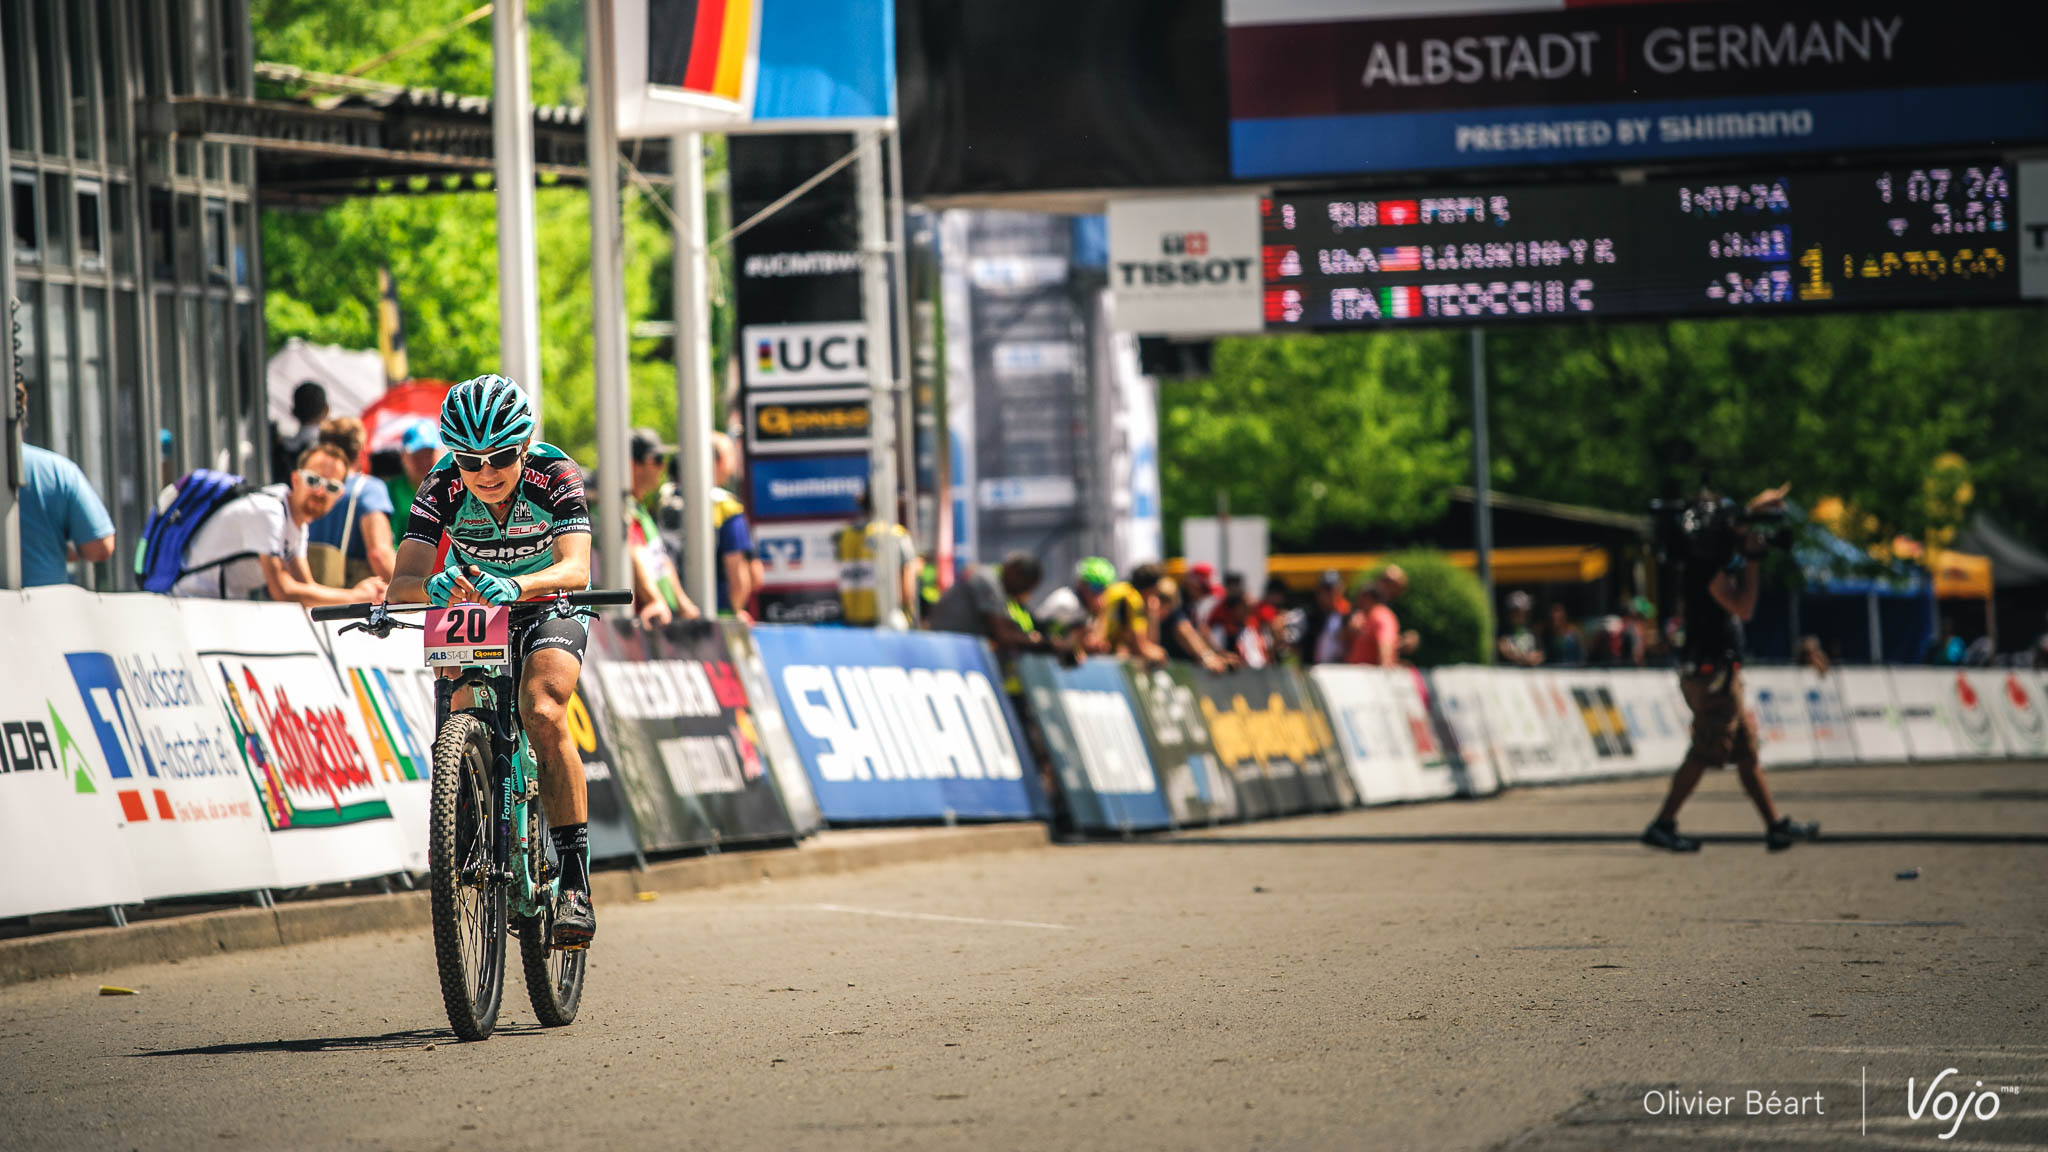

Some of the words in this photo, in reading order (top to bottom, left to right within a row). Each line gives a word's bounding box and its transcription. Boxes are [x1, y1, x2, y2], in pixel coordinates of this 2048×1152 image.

[1361, 31, 1600, 88] ALBSTADT
[1643, 15, 1903, 74] GERMANY
[1454, 119, 1612, 152] PRESENTED
[1616, 117, 1651, 145] BY
[1659, 109, 1813, 142] SHIMANO
[1118, 257, 1254, 287] TISSOT
[778, 336, 866, 372] UCI
[446, 608, 487, 644] 20
[474, 650, 503, 659] GONSO
[782, 664, 1024, 782] SHIMANO
[501, 777, 512, 821] Formula
